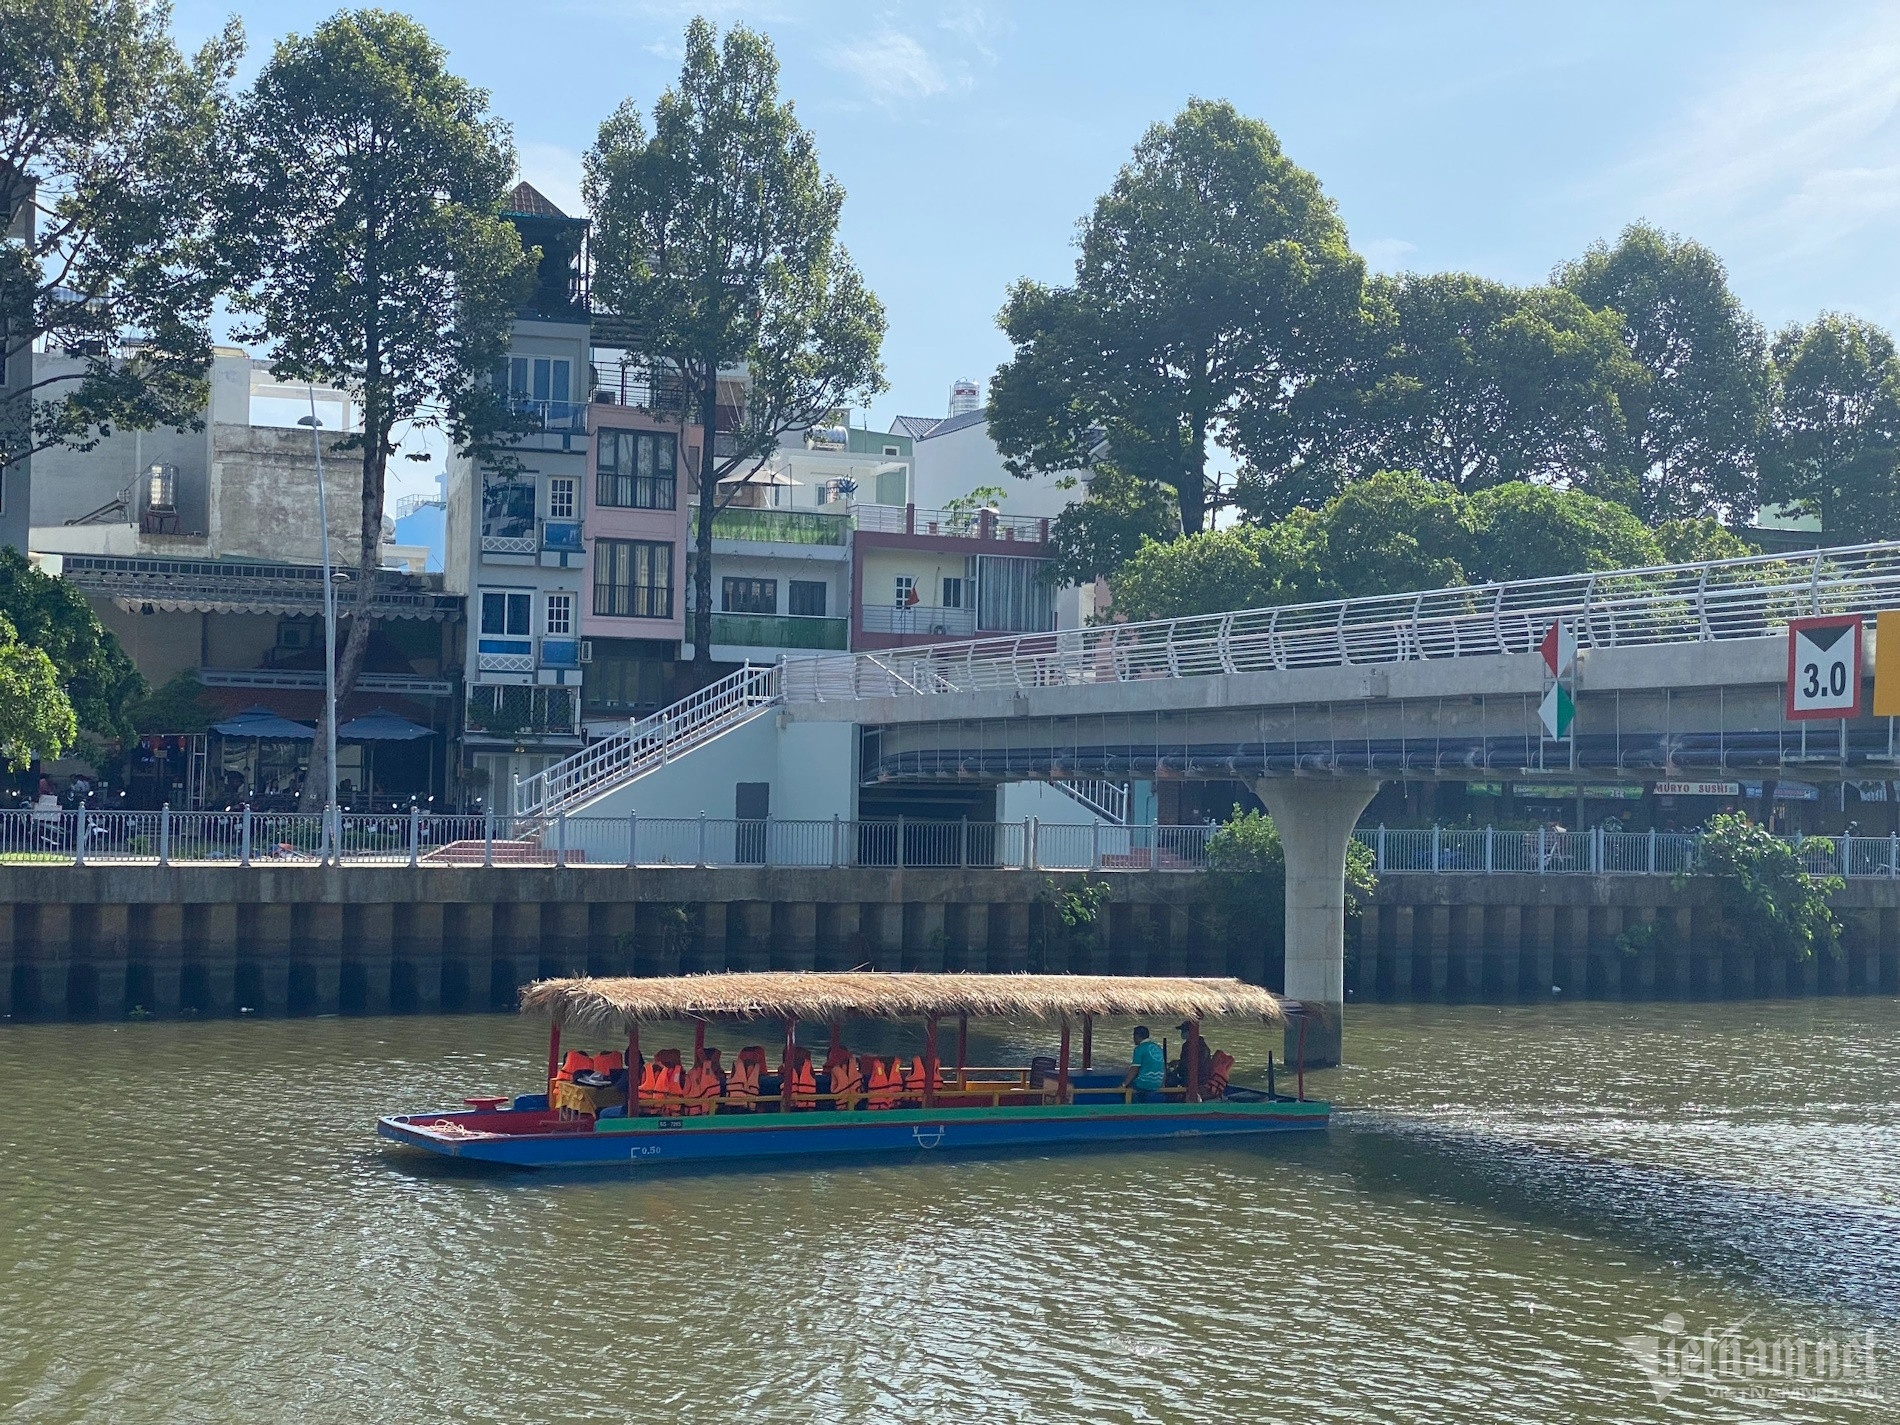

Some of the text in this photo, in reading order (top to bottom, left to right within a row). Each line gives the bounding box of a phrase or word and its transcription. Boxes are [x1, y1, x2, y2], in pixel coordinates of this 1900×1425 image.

[1803, 661, 1846, 698] 3.0
[1698, 783, 1728, 793] SUSHI
[641, 1146, 661, 1155] 0.50
